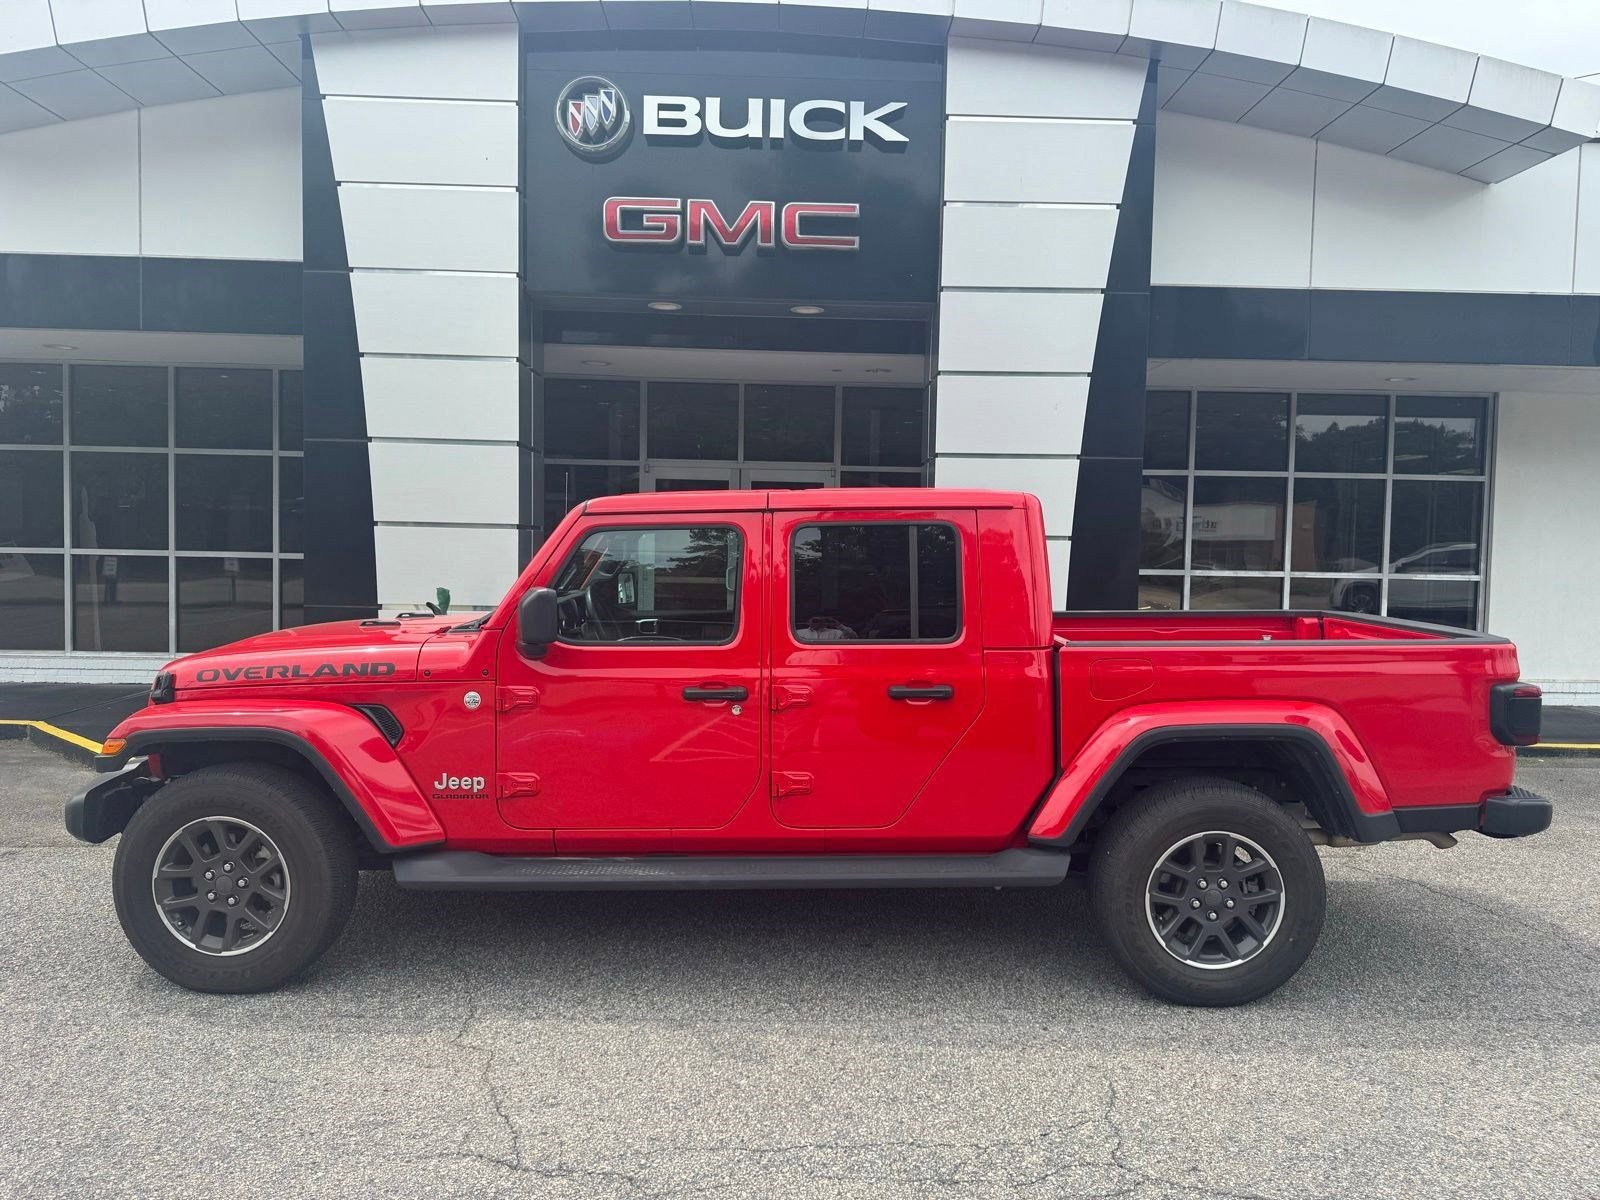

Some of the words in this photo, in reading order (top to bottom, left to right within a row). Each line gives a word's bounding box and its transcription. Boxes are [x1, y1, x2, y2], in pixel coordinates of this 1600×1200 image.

[643, 94, 910, 142] BUICK
[602, 196, 860, 250] GMC
[196, 662, 396, 682] OVERLAND
[434, 772, 485, 793] Jeep
